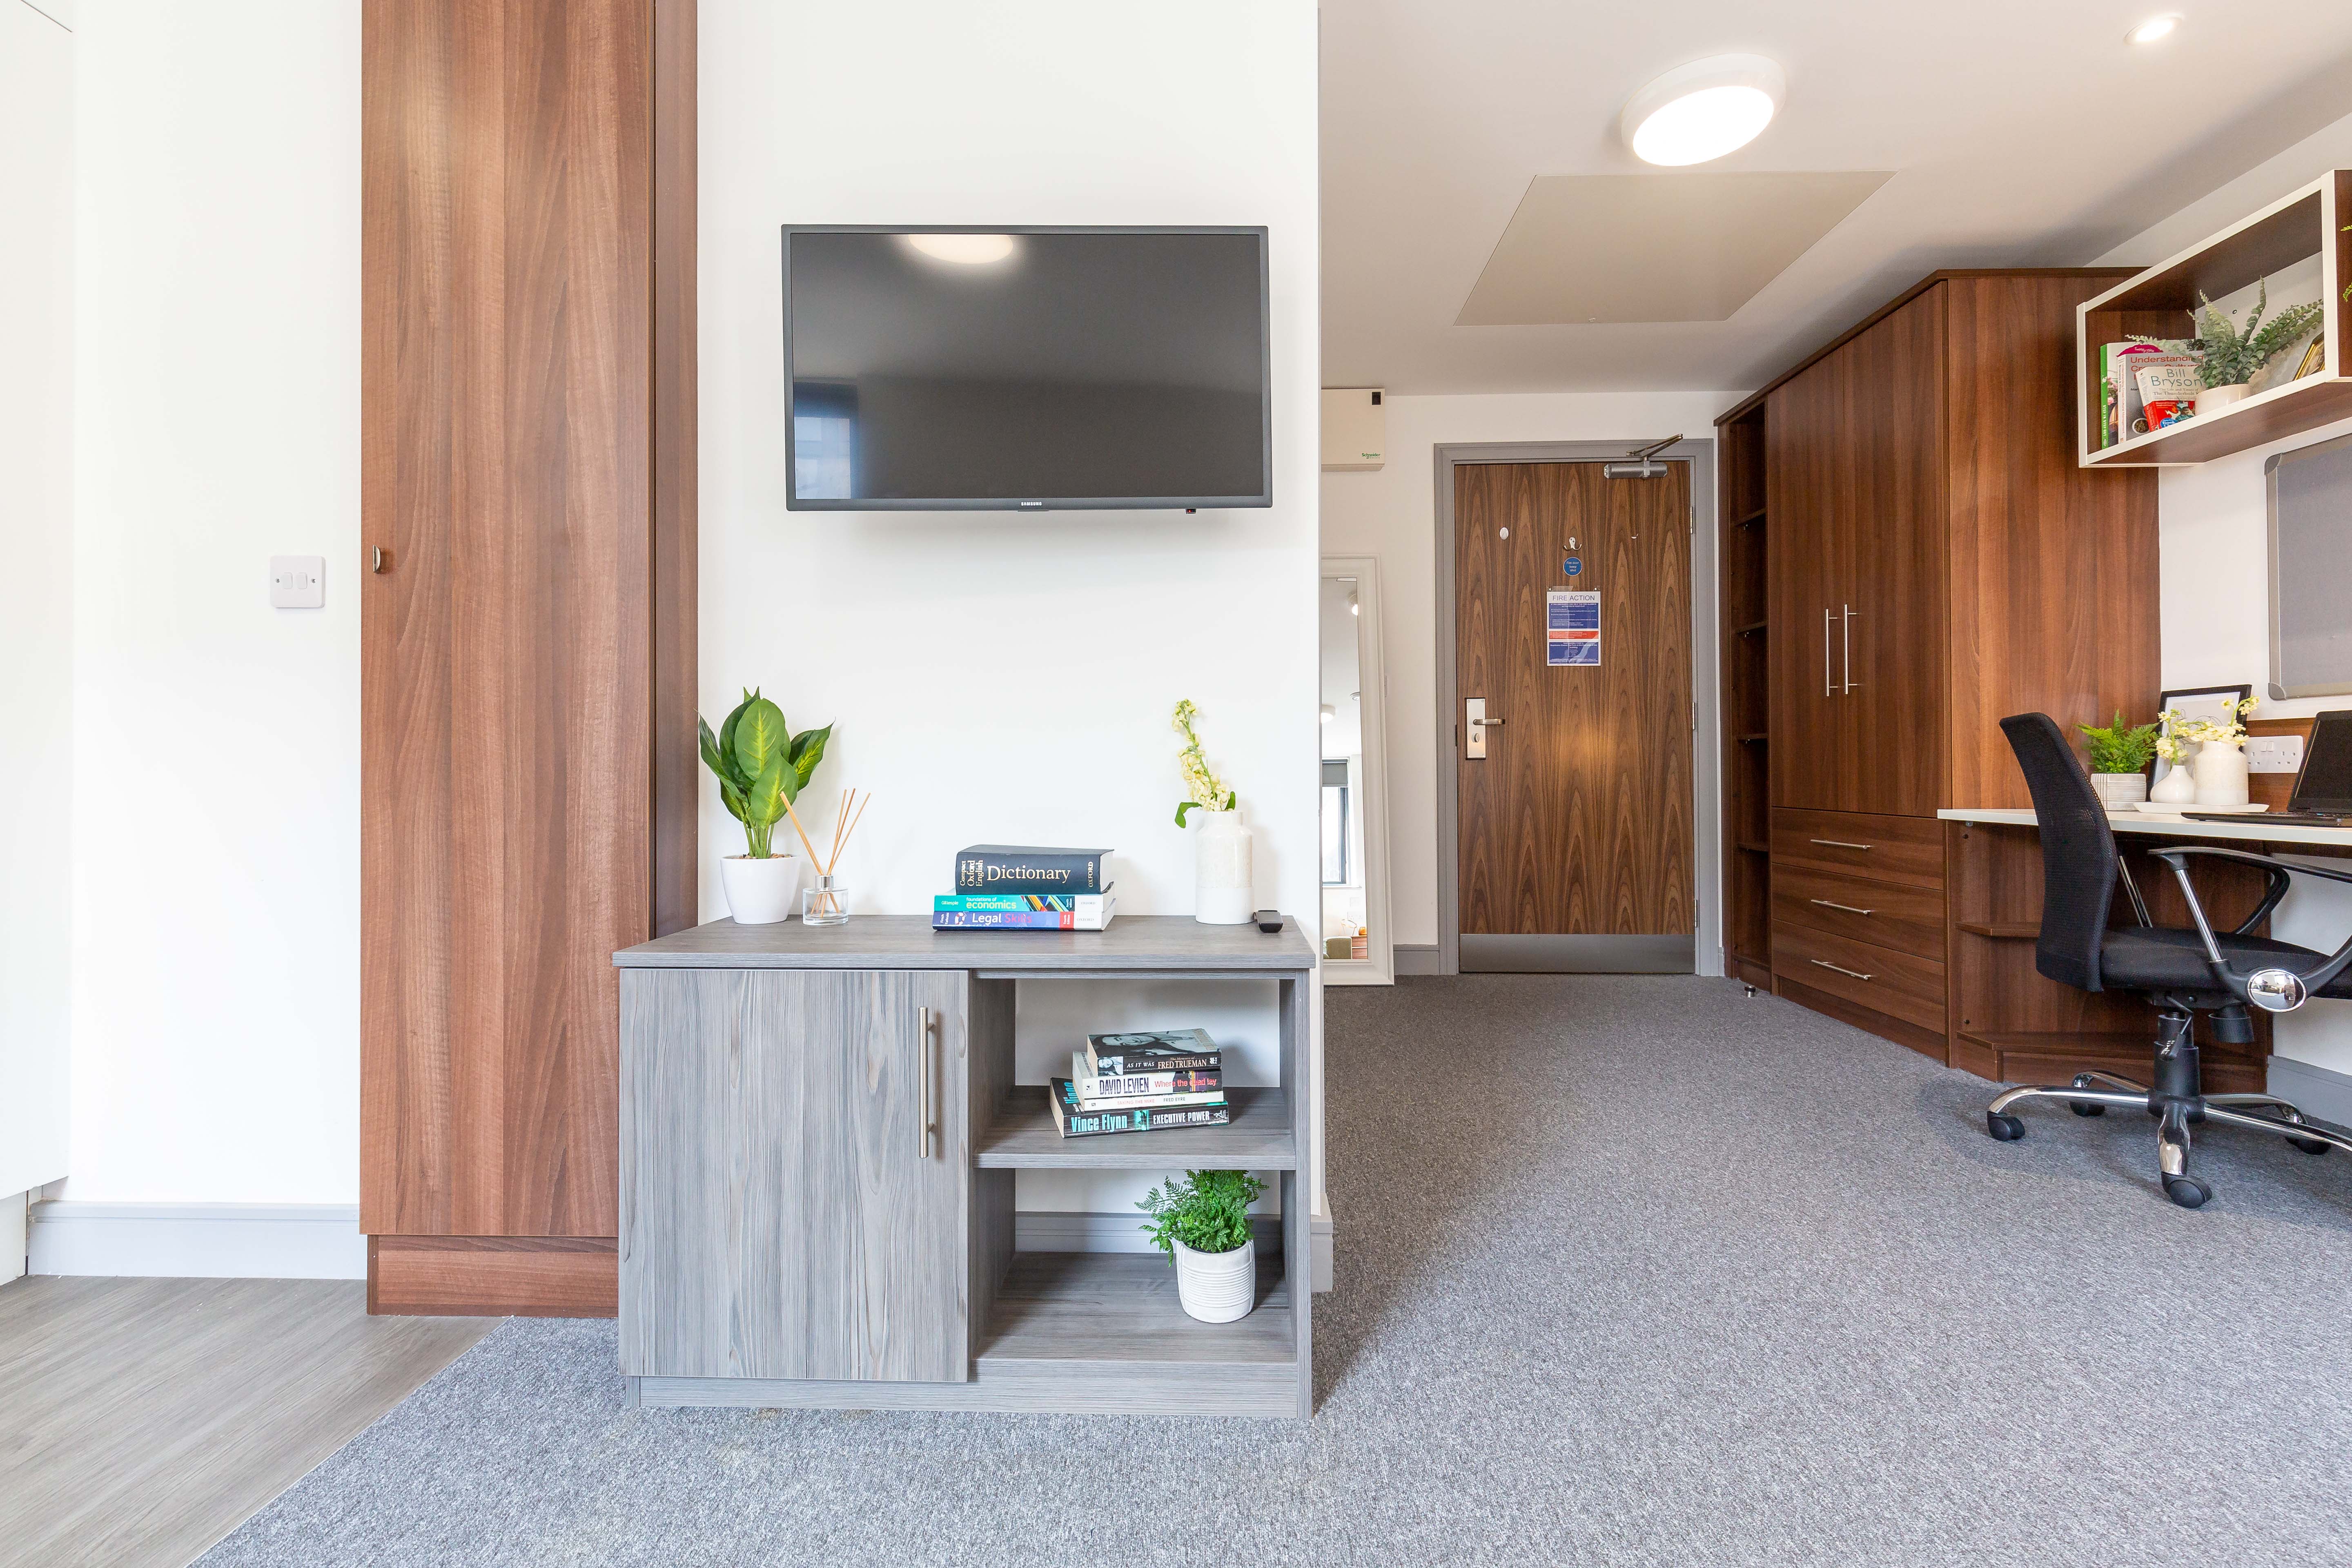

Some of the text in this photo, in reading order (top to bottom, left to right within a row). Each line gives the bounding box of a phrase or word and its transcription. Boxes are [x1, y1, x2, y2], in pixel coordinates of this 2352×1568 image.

[2130, 355, 2203, 363] Understandig
[2166, 369, 2185, 378] Bill
[2151, 376, 2203, 388] Bryson
[967, 860, 975, 886] Oxford
[976, 860, 984, 886] English
[987, 864, 1071, 884] Dictionary
[966, 900, 1016, 909] economics
[972, 913, 1032, 925] Legal Skills
[1158, 1059, 1207, 1069] FRED TRUEMAN
[1100, 1077, 1149, 1095] DAVID LEVIEN
[1207, 1078, 1217, 1086] lay
[1071, 1114, 1127, 1133] Vince Flynn
[1153, 1111, 1210, 1125] EXECUTIVE POWER
